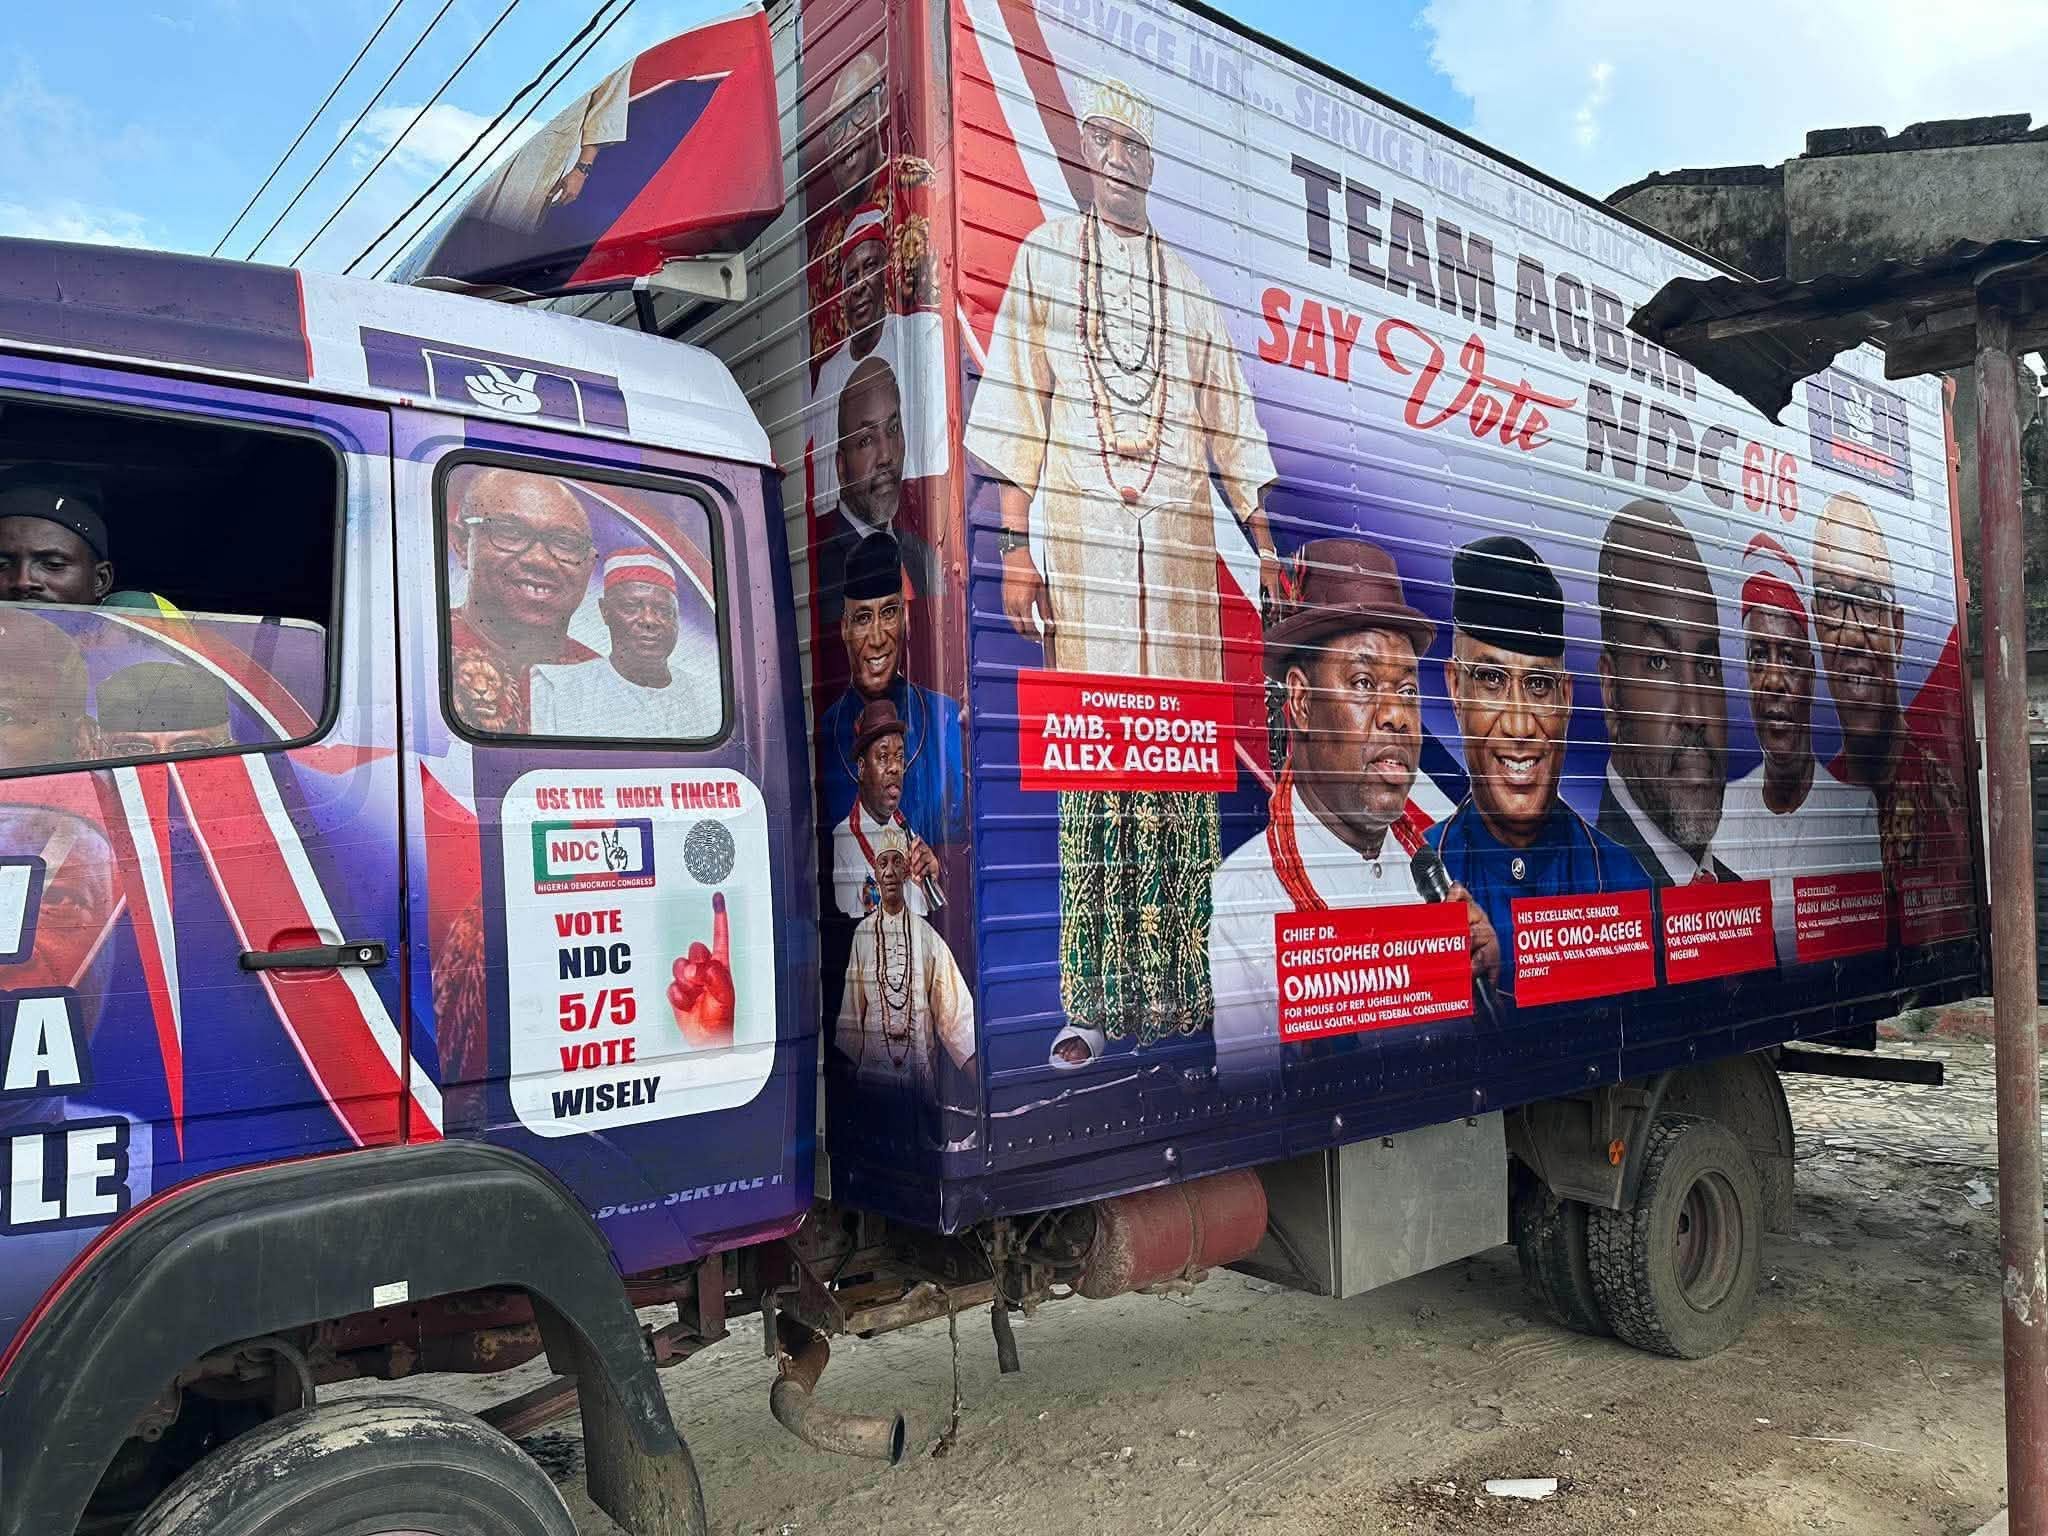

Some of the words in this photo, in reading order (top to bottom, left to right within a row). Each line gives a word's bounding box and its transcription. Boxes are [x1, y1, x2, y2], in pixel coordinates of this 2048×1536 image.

[1293, 86, 1415, 176] SERVICE
[1291, 153, 1496, 329] TEAM
[1258, 287, 1362, 383] SAY
[1376, 318, 1578, 451] Vote
[1586, 378, 1738, 510] NDC
[1742, 441, 1799, 522] 6/6
[1081, 691, 1155, 710] POWERED
[1160, 695, 1181, 711] BY:
[1041, 713, 1112, 740] AMB.
[1120, 716, 1218, 743] TOBORE
[1043, 743, 1116, 771] ALEX
[1124, 745, 1220, 773] AGBAH
[536, 788, 570, 810] USE
[572, 787, 605, 809] THE
[616, 786, 664, 808] INDEX
[671, 781, 741, 809] FINGER
[552, 840, 599, 863] NDC
[538, 882, 569, 893] NIGERIA
[571, 879, 616, 890] DEMOCRATIC
[617, 878, 653, 888] CONGRESS
[1518, 912, 1532, 924] HIS
[1535, 908, 1585, 921] EXCELLENCY,
[1666, 913, 1702, 934] CHRIS
[1706, 906, 1762, 929] IYOVWAYE
[1797, 901, 1819, 915] RABIU
[1820, 899, 1840, 912] MUSA
[555, 909, 622, 937] VOTE
[1283, 927, 1315, 943] CHIEF
[1319, 926, 1337, 940] DR.
[1518, 928, 1553, 950] OVIE
[1558, 920, 1643, 947] OMO-AGEGE
[1667, 937, 1681, 947] FOR
[1682, 932, 1719, 946] GOVERNOR,
[1719, 930, 1737, 940] DELTA
[1737, 927, 1752, 937] STATE
[558, 943, 631, 980] NDC
[1281, 943, 1379, 967] CHRISTOPHER
[1383, 936, 1465, 956] OBIUVWEVBI
[1519, 954, 1534, 965] FOR
[1564, 949, 1585, 959] DELTA
[1585, 945, 1613, 958] CENTRAL
[1284, 964, 1410, 1002] OMINIMINI
[1519, 967, 1550, 978] DISTRICT
[559, 987, 636, 1032] 5/5
[1284, 1007, 1302, 1019] FOR
[1304, 1003, 1334, 1016] HOUSE
[1336, 1001, 1348, 1011] OF
[1350, 1000, 1365, 1010] REP.
[1367, 995, 1400, 1008] UGHELLI
[1404, 991, 1433, 1003] NORTH,
[1285, 1020, 1322, 1034] UGHELLI
[1324, 1014, 1356, 1029] SOUTH,
[1358, 1012, 1377, 1023] UDU
[1378, 1006, 1411, 1021] FEDERAL
[1413, 1000, 1469, 1016] CONSTITUENCY
[559, 1037, 636, 1072] VOTE
[552, 1076, 660, 1118] WISELY
